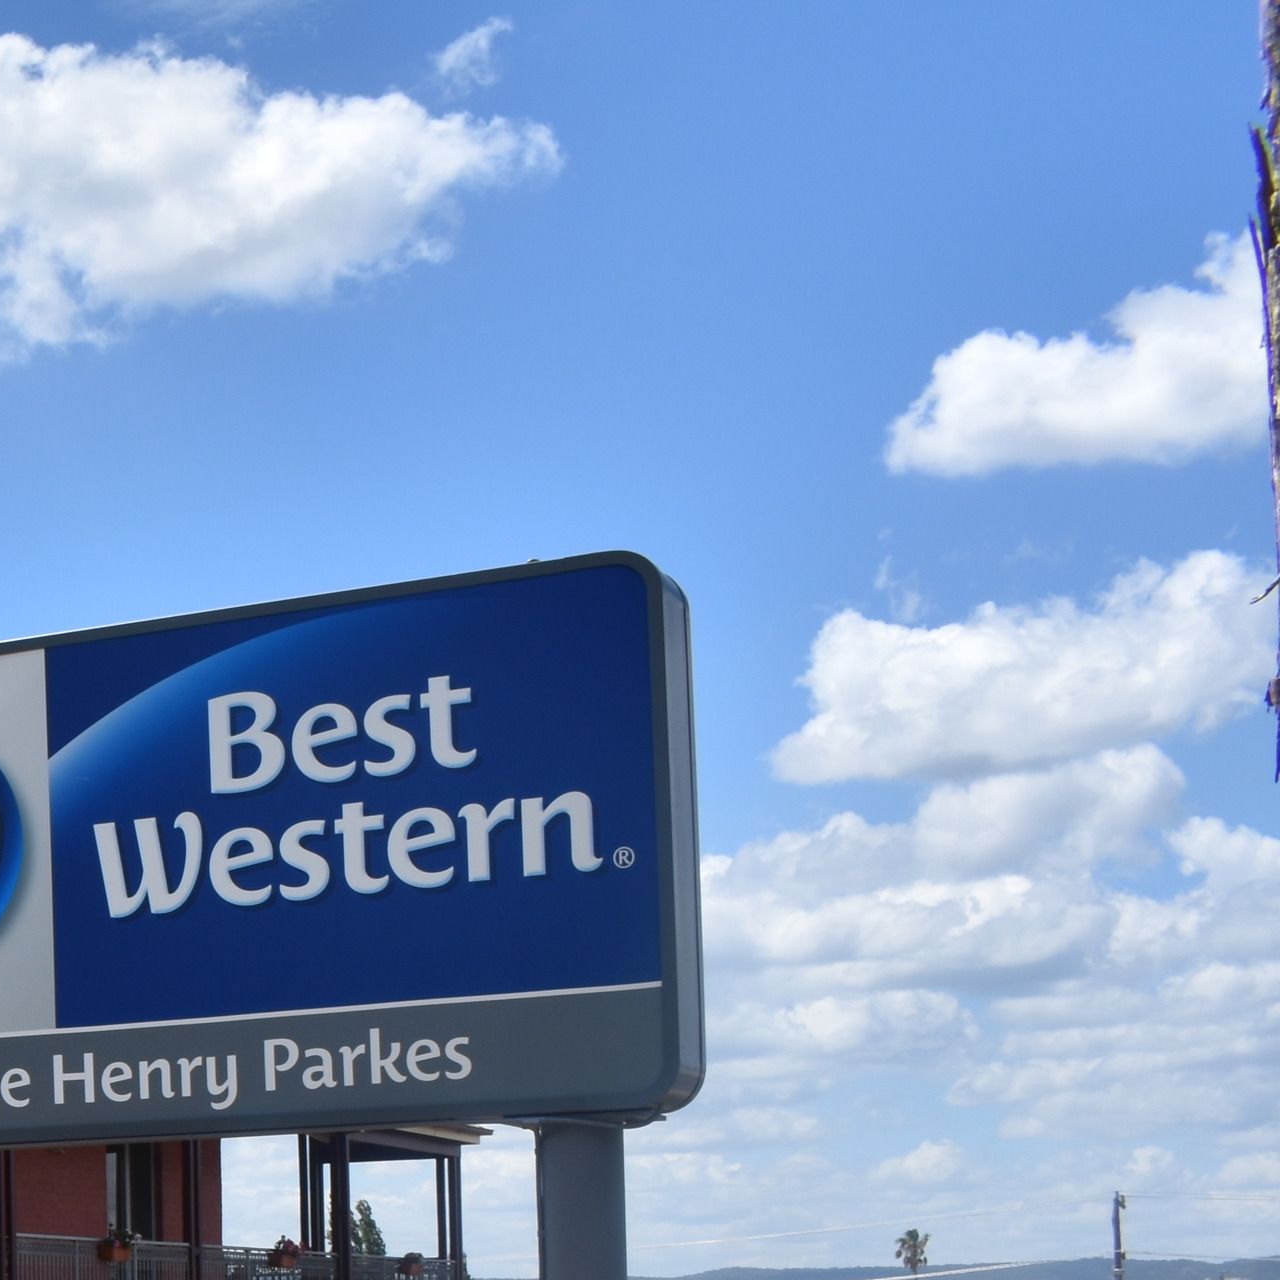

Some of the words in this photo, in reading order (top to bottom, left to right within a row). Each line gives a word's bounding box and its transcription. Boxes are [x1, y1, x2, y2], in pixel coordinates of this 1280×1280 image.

[208, 675, 477, 794] Best
[52, 1052, 238, 1110] Henry
[262, 1028, 472, 1092] Parkes
